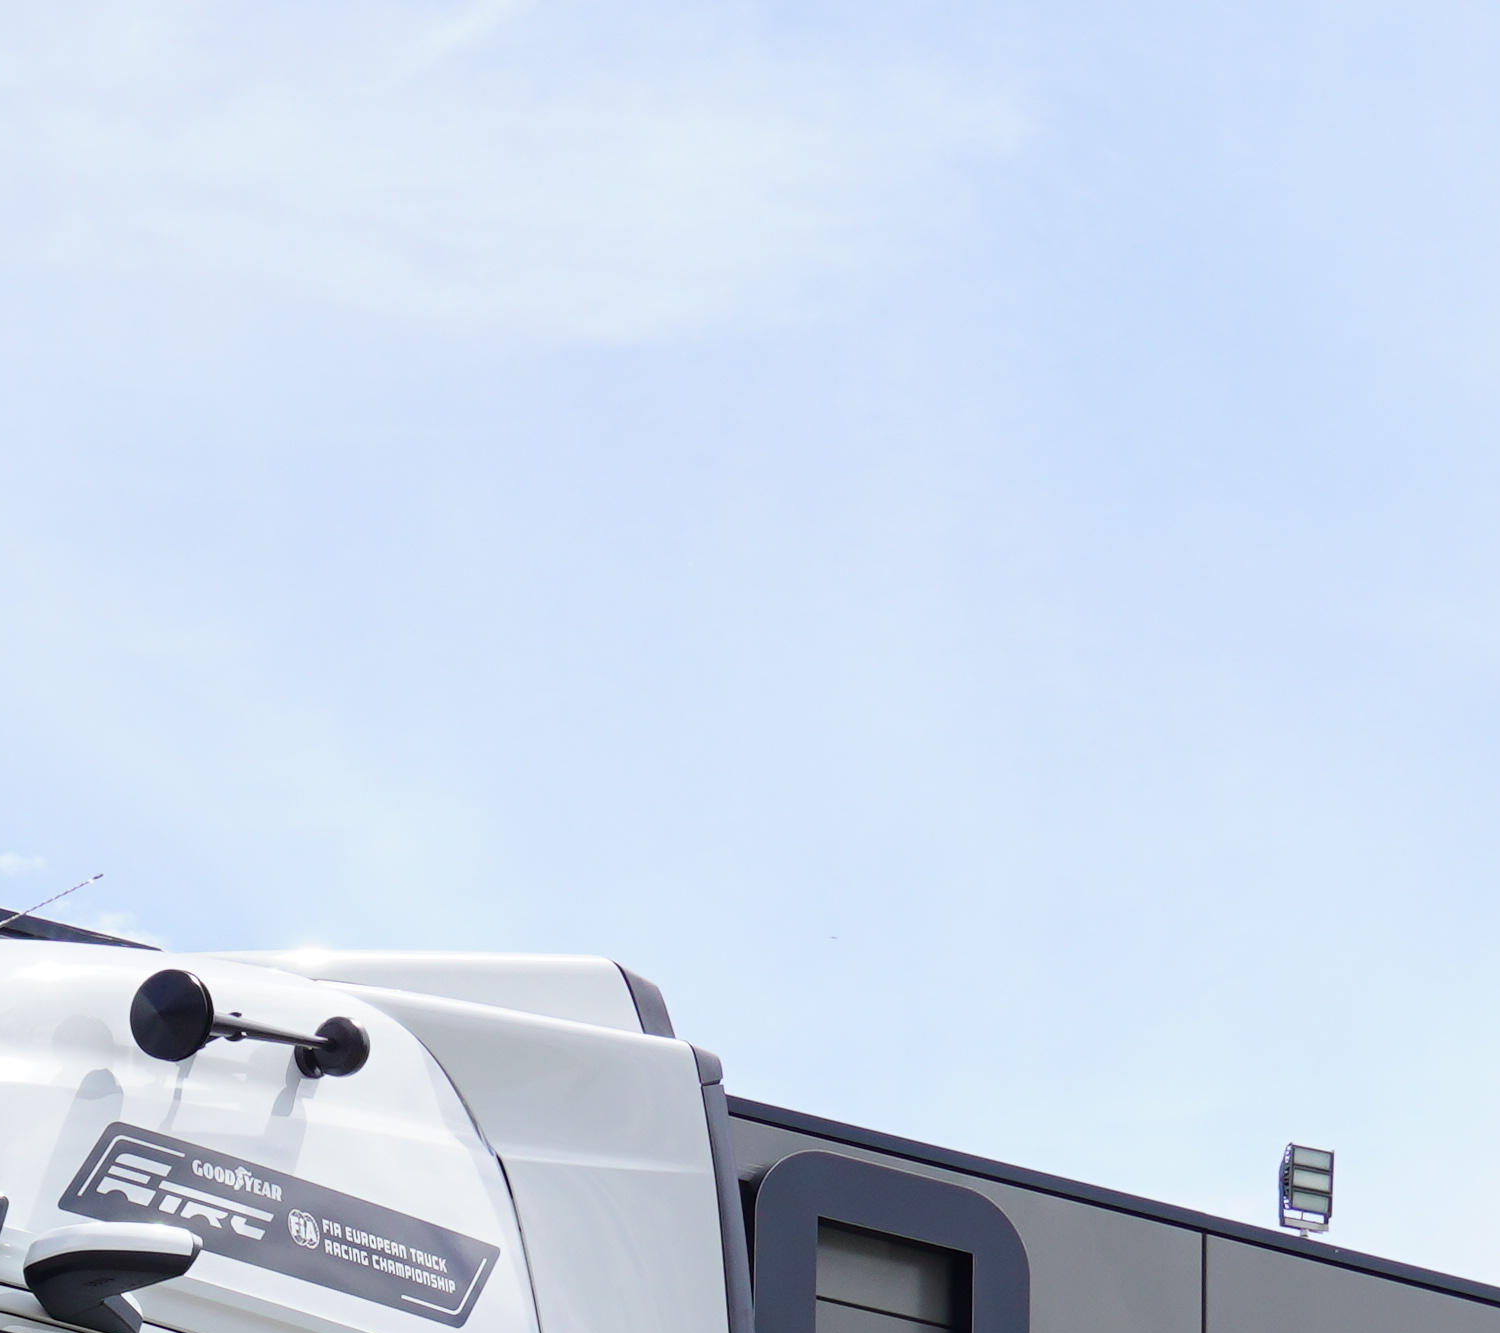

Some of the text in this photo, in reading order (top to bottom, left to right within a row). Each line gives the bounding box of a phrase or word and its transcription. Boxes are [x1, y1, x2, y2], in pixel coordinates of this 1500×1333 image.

[192, 1159, 283, 1201] GOODYEAR
[288, 1213, 318, 1243] FIA
[321, 1219, 448, 1273] FIA EUROPEAN TRUCK
[324, 1239, 456, 1294] RACING CHAMPIONSHIP
